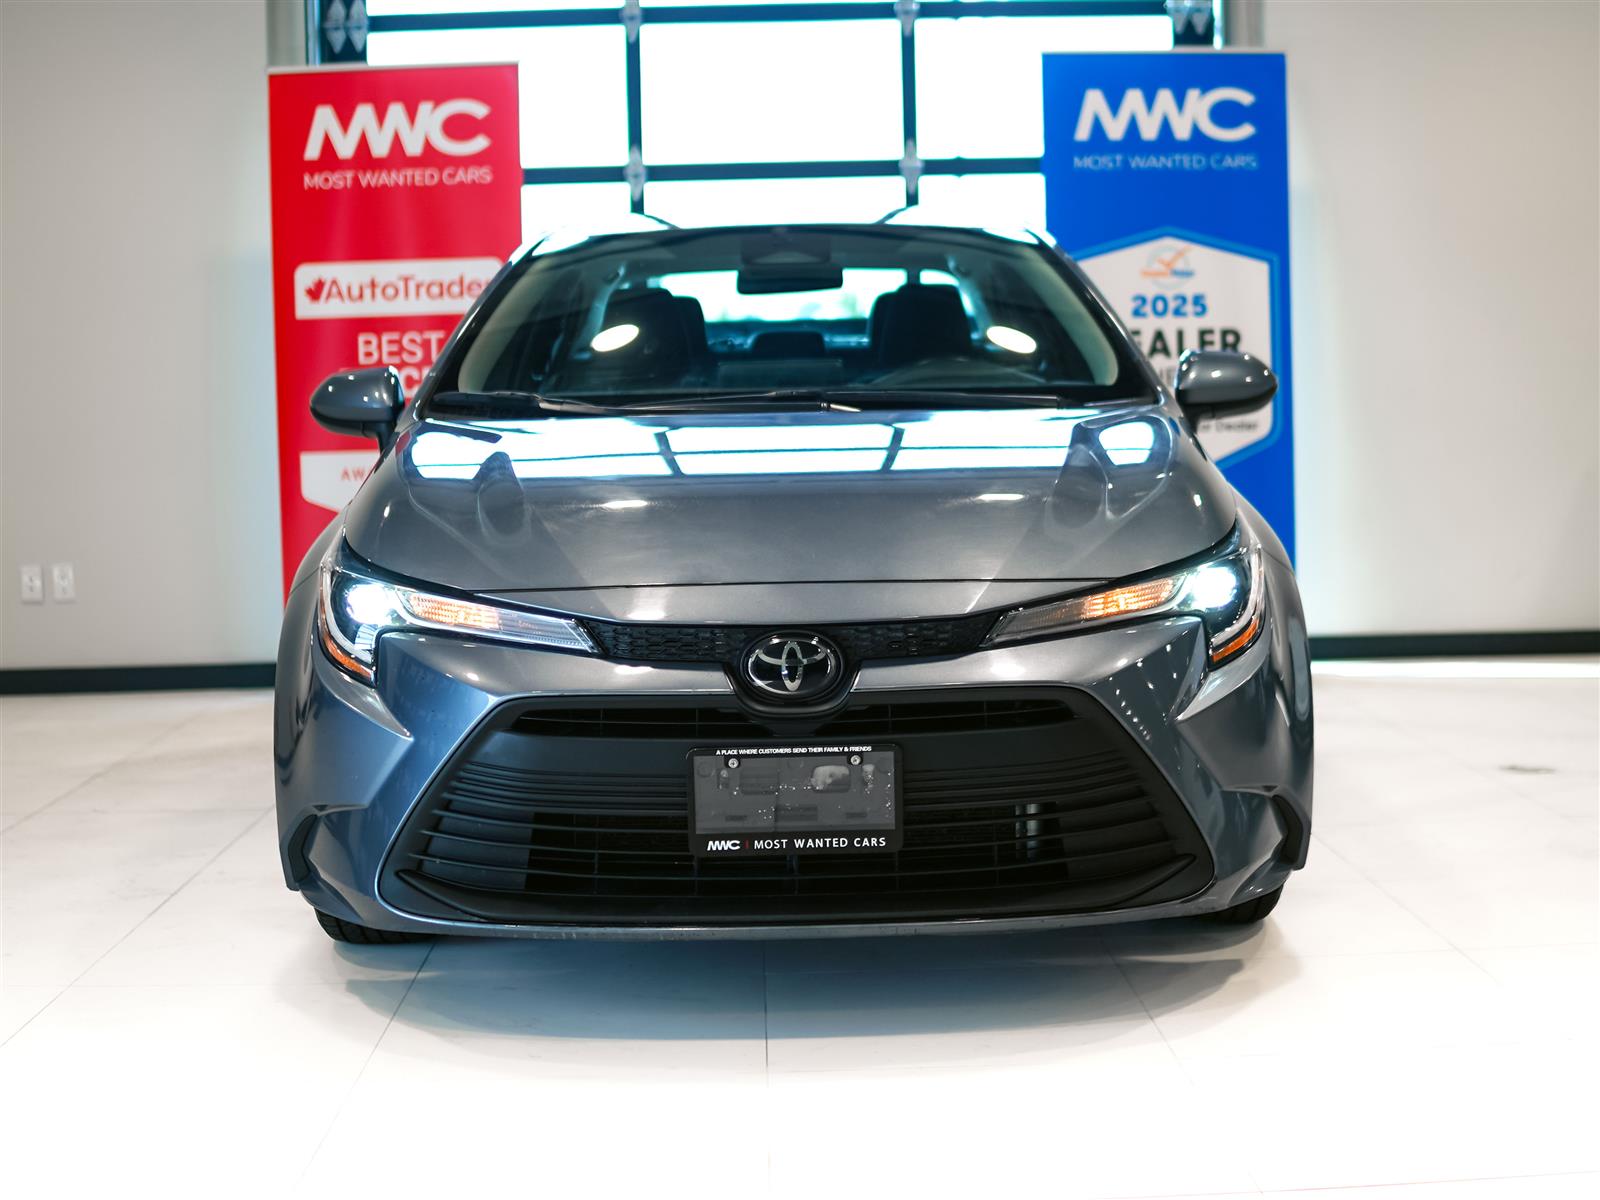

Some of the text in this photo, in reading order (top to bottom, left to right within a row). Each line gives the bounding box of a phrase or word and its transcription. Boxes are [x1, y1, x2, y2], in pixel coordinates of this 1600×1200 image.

[1074, 87, 1256, 142] MWC
[303, 98, 491, 161] MWC
[1073, 153, 1258, 170] MOST WANTED CARS
[303, 165, 493, 191] MOST WANTED CARS
[1131, 294, 1208, 318] 2025
[357, 330, 446, 365] BEST
[707, 837, 886, 851] MWC MOST WANTED CARS
